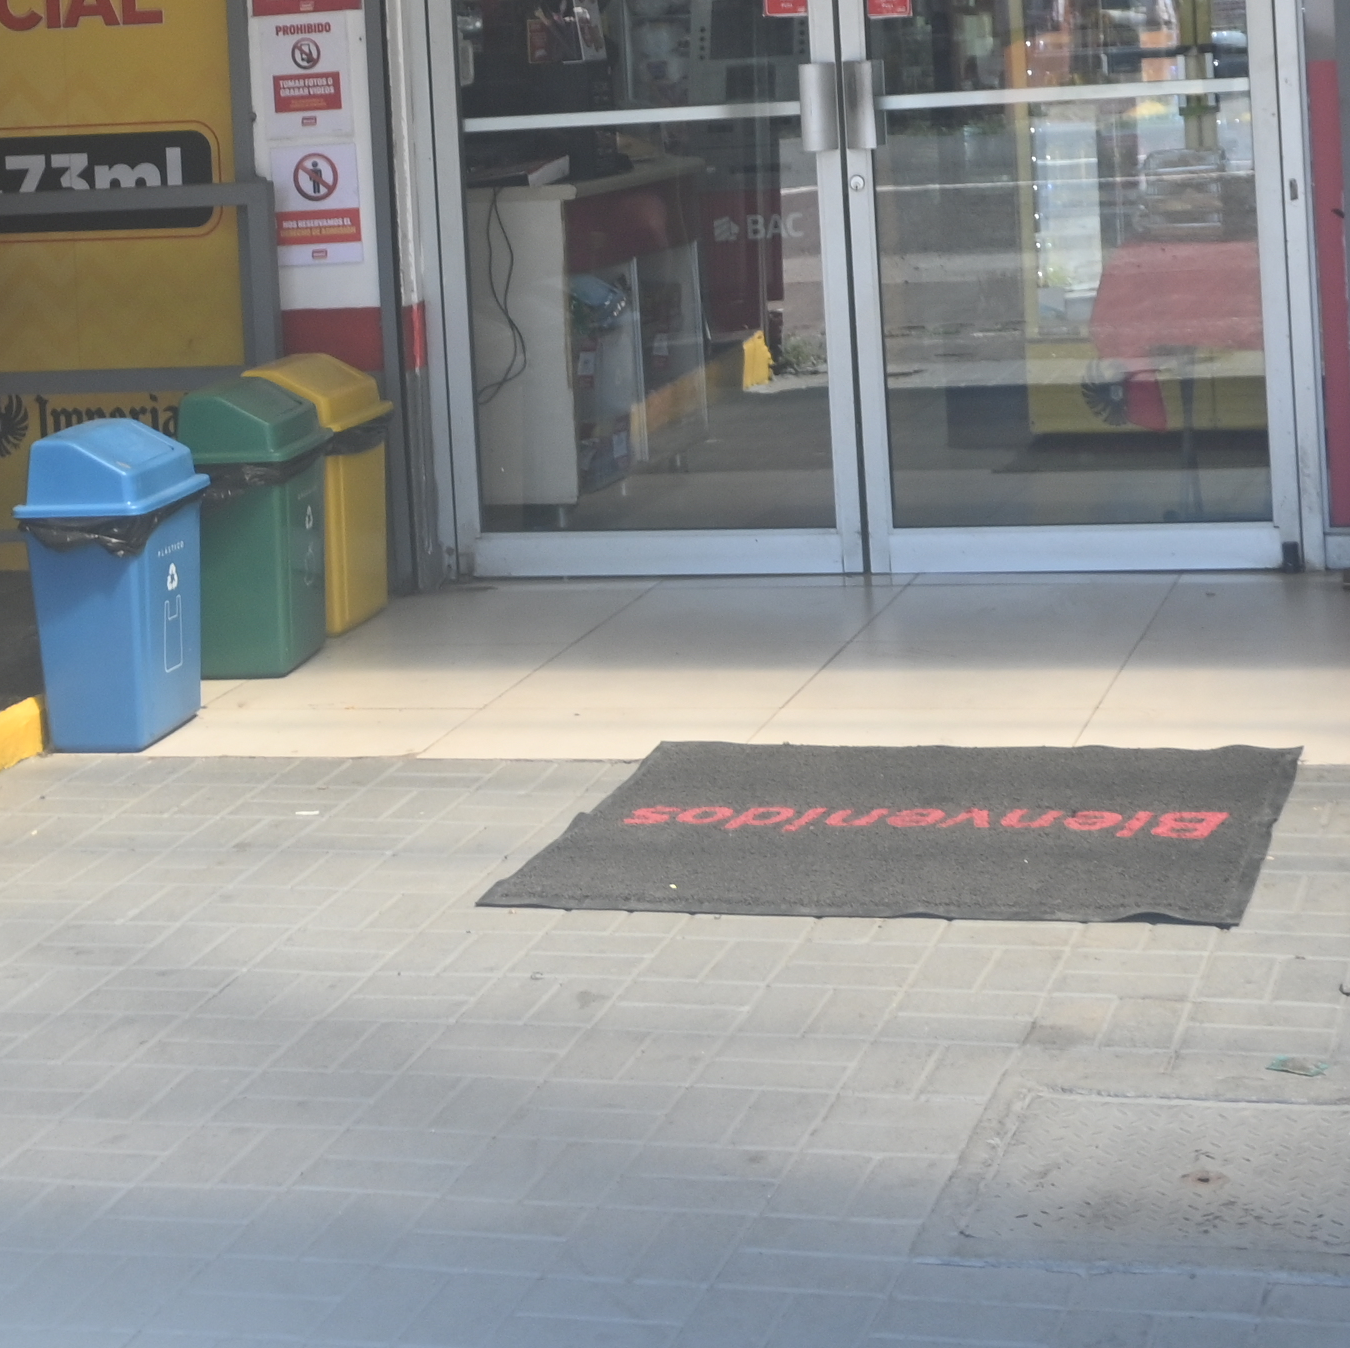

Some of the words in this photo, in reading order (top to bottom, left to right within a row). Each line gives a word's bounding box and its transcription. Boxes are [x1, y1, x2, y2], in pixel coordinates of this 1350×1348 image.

[275, 22, 332, 36] PROHIBIDO
[279, 79, 304, 89] TOMAR
[305, 78, 327, 87] FOTOS
[280, 88, 309, 97] GRABAR
[746, 212, 804, 240] BAC
[622, 804, 1231, 841] Bienvenidos
